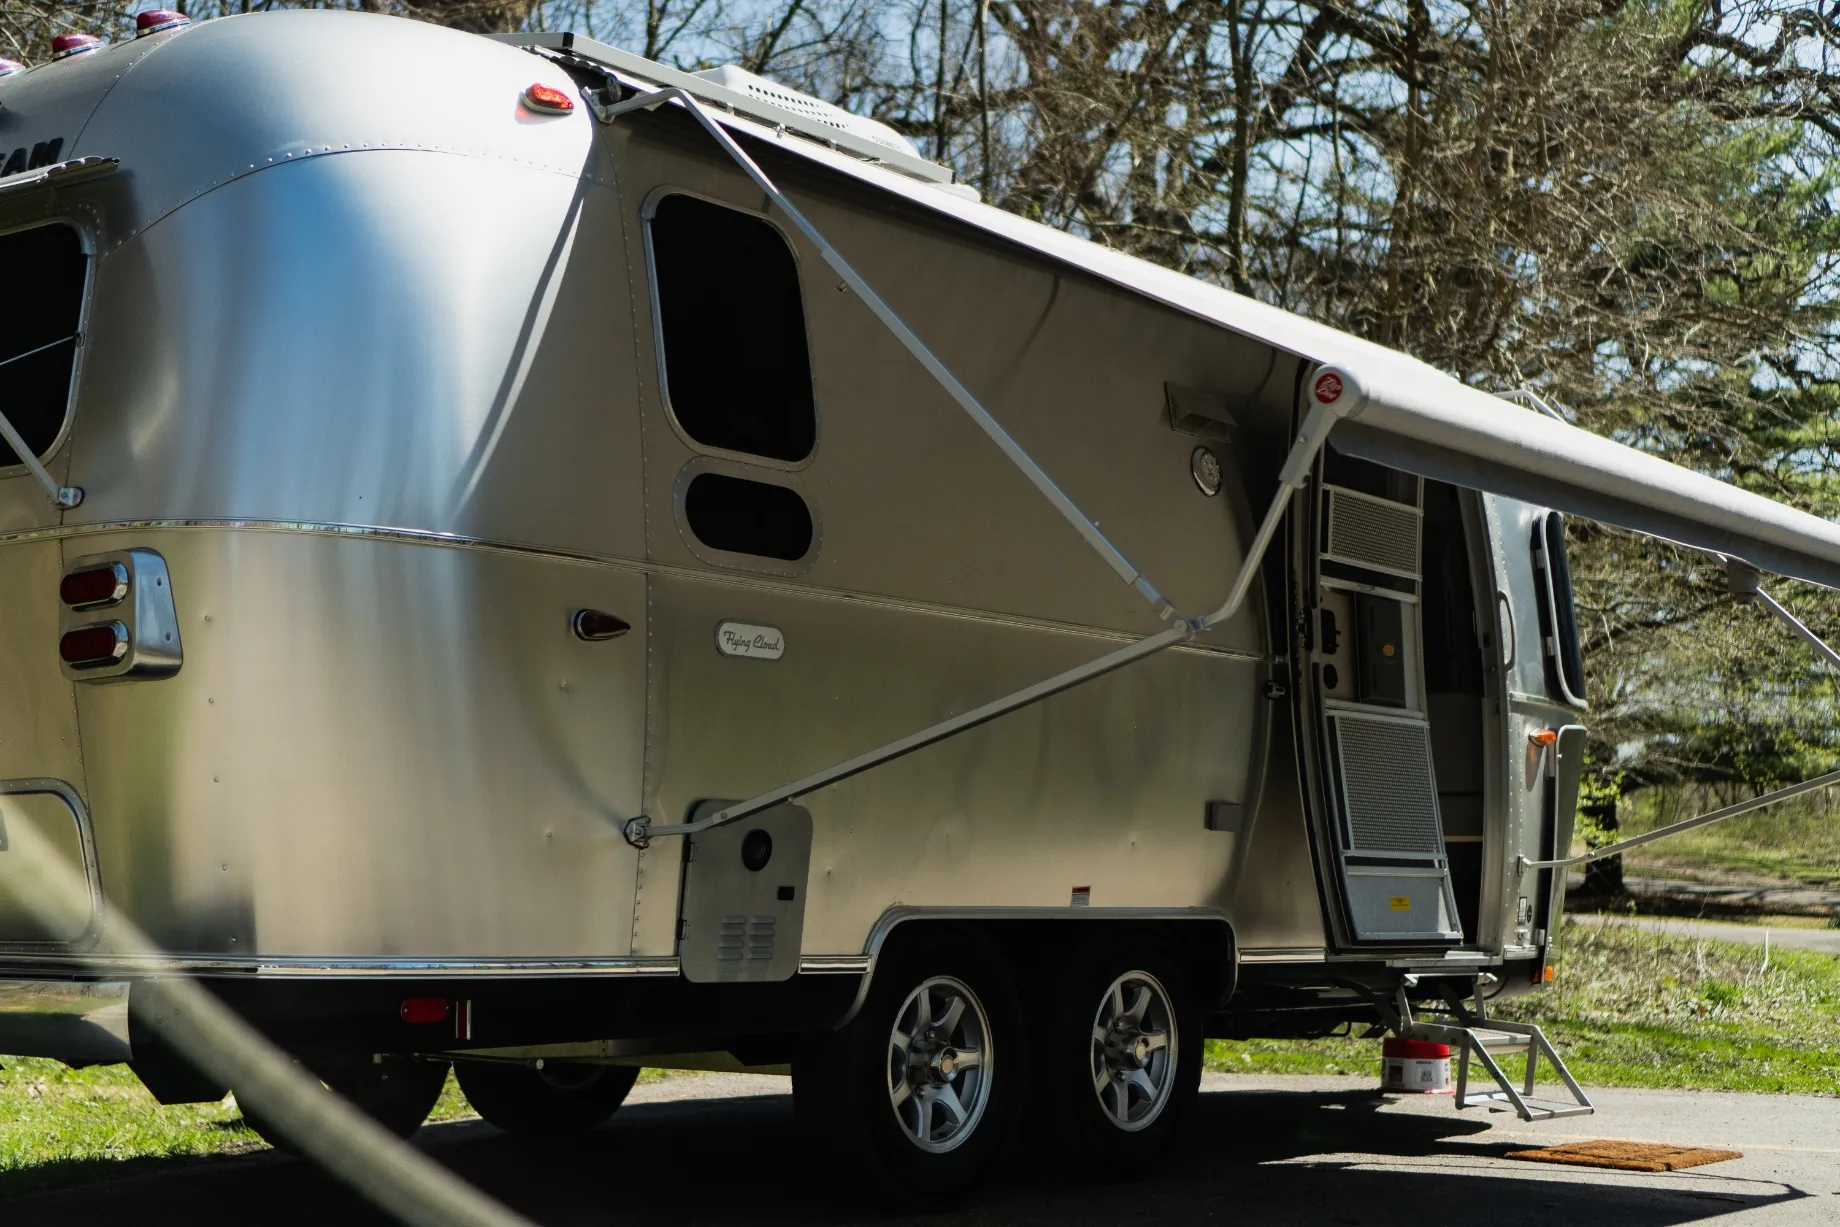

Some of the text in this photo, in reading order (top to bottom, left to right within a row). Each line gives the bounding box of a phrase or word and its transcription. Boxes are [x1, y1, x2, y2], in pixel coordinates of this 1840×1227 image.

[0, 137, 64, 178] AM
[723, 630, 780, 652] Flying Cloud
